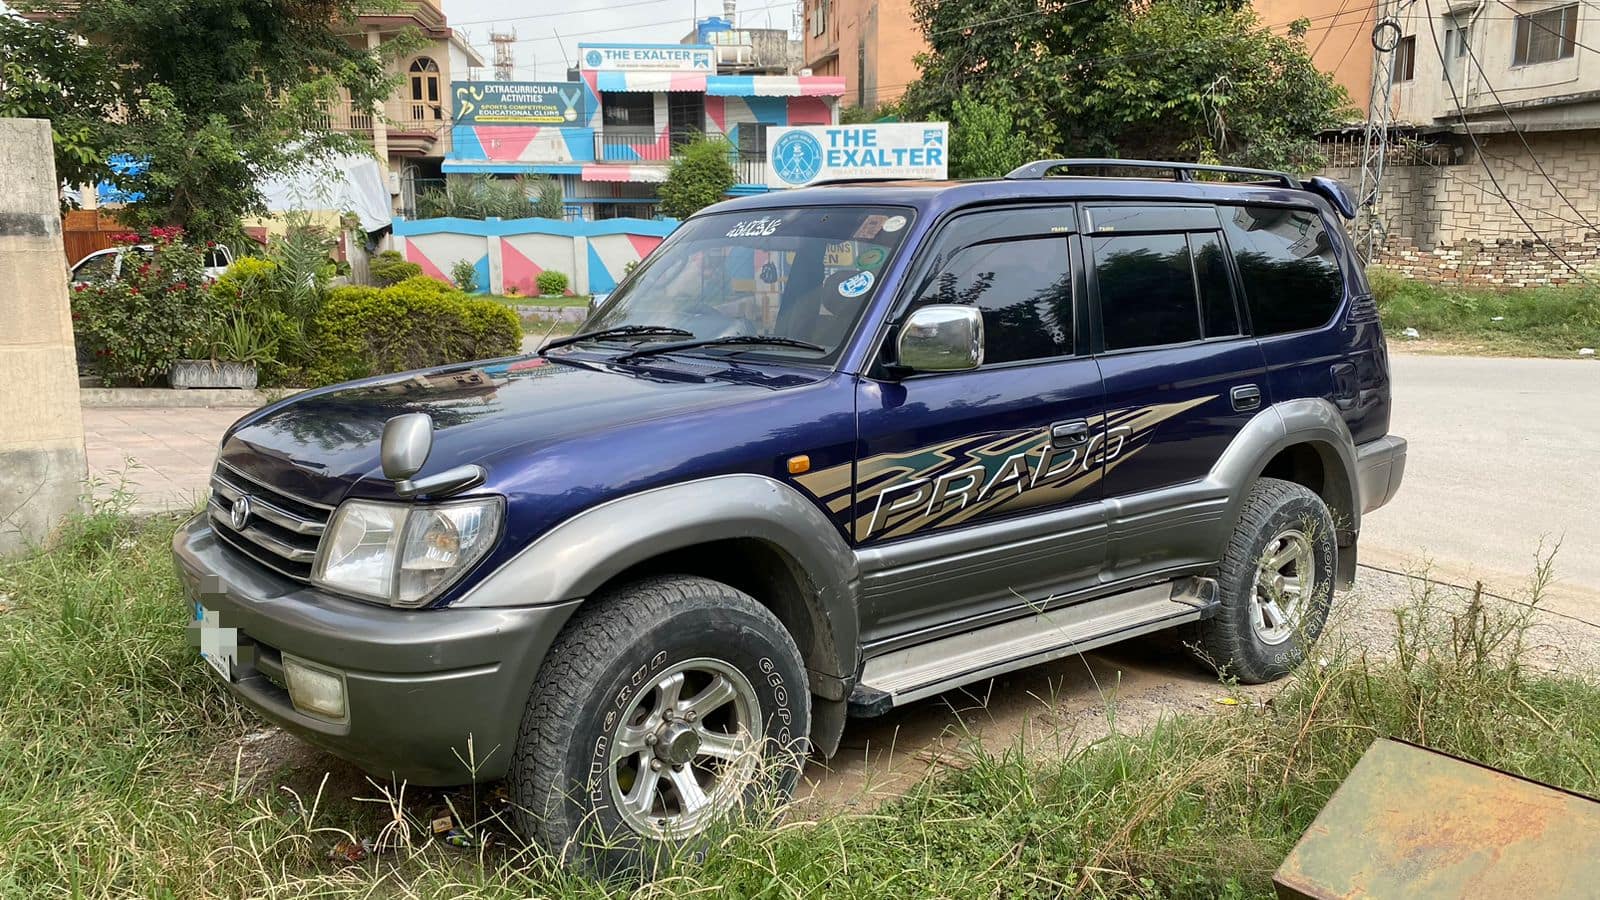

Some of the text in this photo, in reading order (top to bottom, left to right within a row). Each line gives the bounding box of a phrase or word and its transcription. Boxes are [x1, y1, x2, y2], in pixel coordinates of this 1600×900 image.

[604, 50, 691, 60] THE EXALTER
[484, 85, 558, 94] EXTRACURRICULAR
[501, 94, 543, 103] ACTIVITIES
[827, 129, 877, 147] THE
[827, 148, 942, 167] EXALTER
[866, 426, 1134, 537] PRADO
